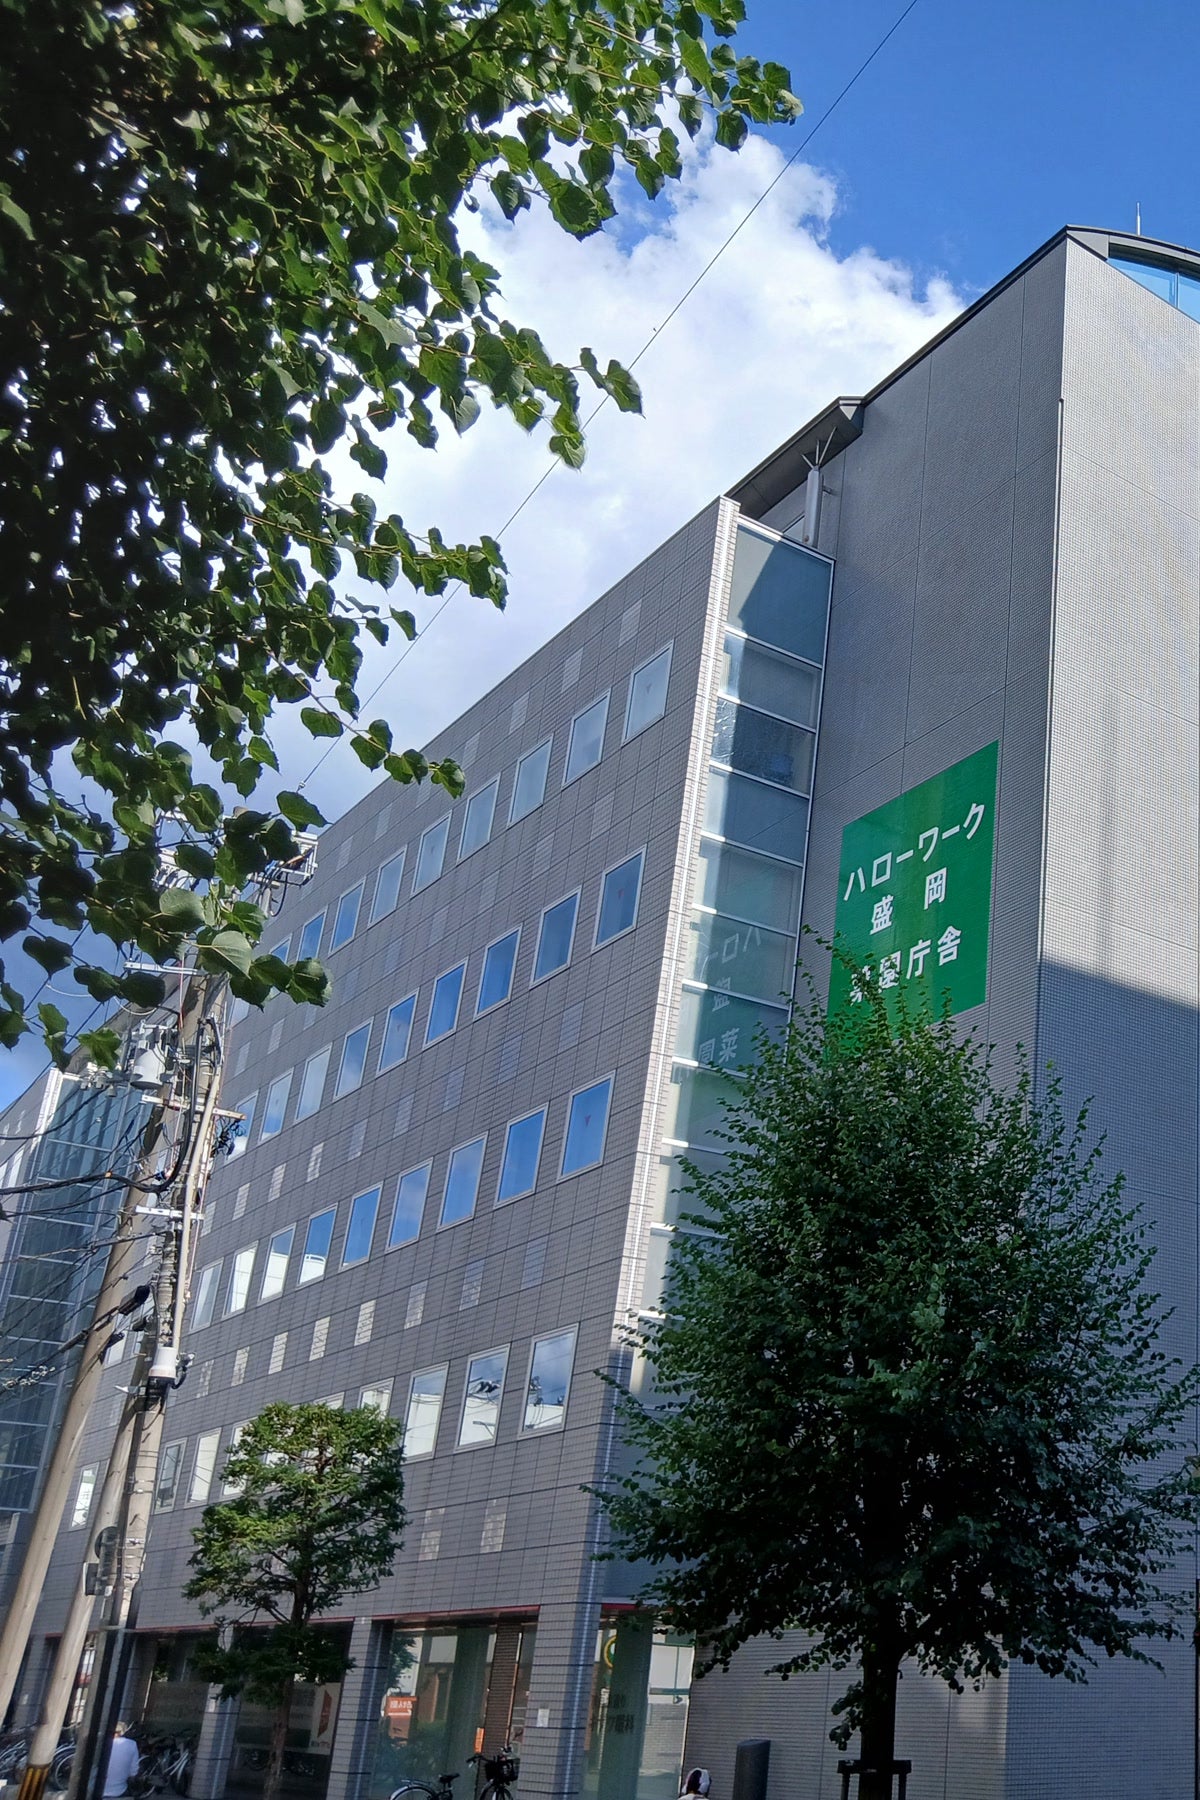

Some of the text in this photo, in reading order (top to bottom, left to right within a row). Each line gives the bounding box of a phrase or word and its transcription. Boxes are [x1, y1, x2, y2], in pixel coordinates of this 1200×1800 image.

[843, 803, 986, 902] ハローワーク
